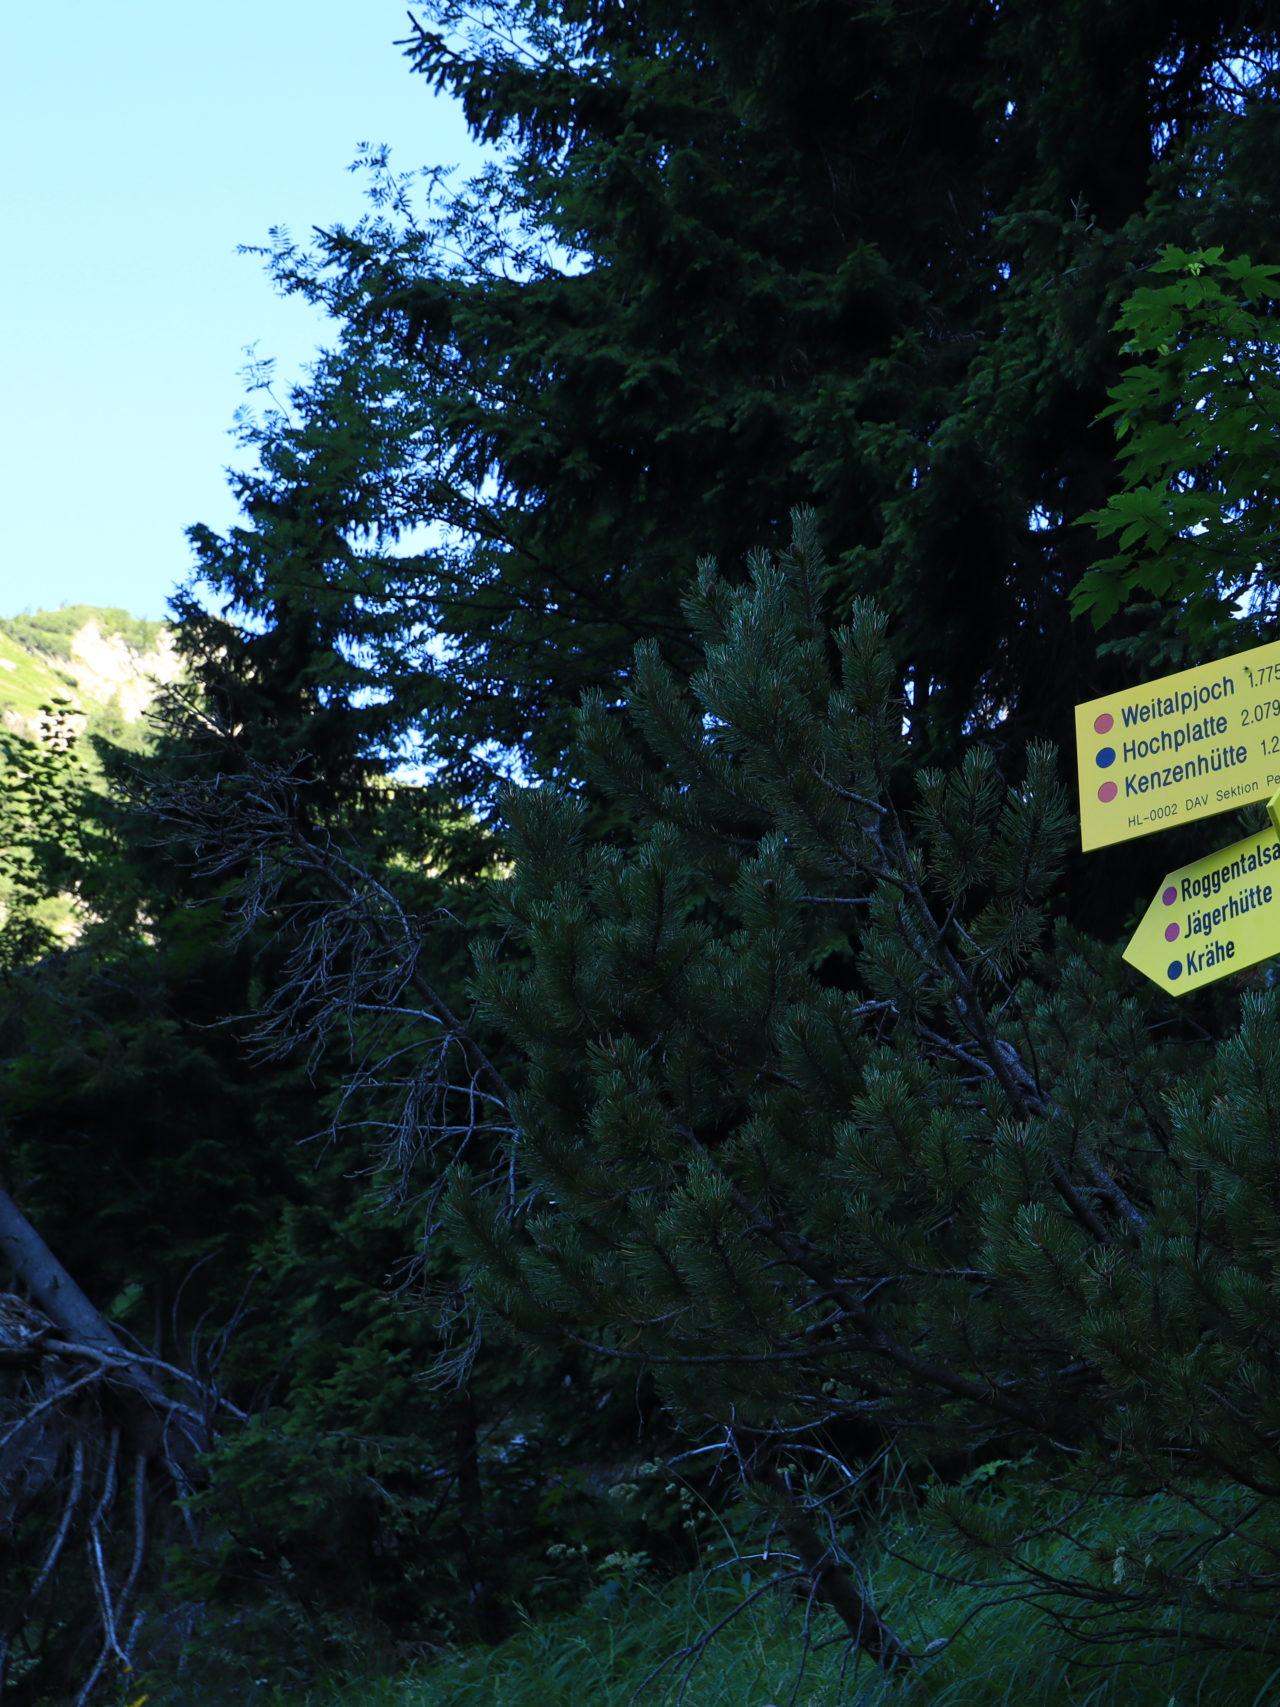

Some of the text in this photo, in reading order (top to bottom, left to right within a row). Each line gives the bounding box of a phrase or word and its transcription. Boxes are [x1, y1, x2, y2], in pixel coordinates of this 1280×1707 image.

[1121, 676, 1235, 728] Weitalpjoch
[1123, 715, 1228, 764] Hochplatte
[1125, 745, 1248, 798] Kenzenhütte
[1127, 779, 1259, 828] HL-0002 DAV Sektion
[1184, 884, 1274, 940] Jägerhütte
[1186, 939, 1236, 977] Krähe
